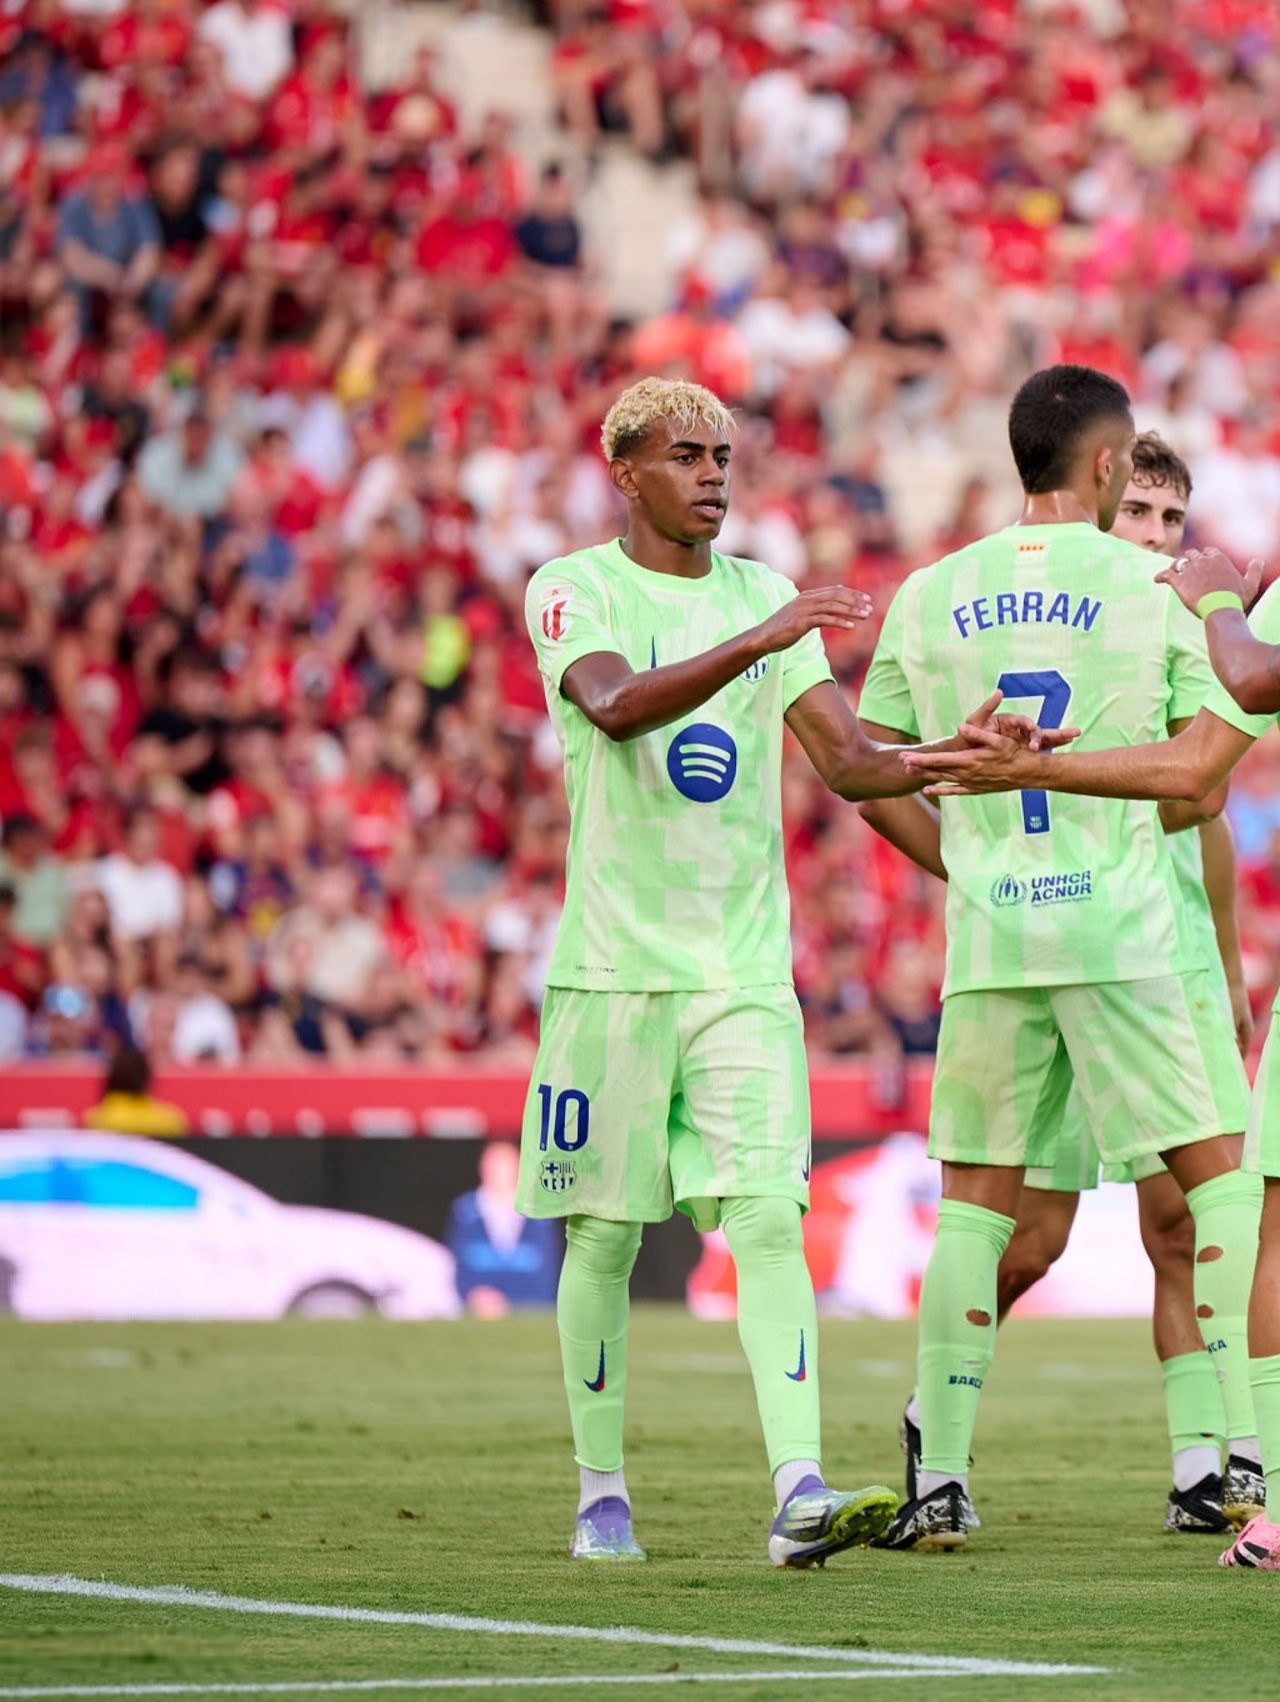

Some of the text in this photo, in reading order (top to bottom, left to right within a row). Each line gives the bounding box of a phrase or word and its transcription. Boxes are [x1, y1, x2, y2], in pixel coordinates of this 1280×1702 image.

[952, 591, 1103, 638] FERRAN
[1031, 870, 1092, 889] UNHCR
[1031, 882, 1092, 903] ACNUR
[537, 1083, 590, 1152] 10
